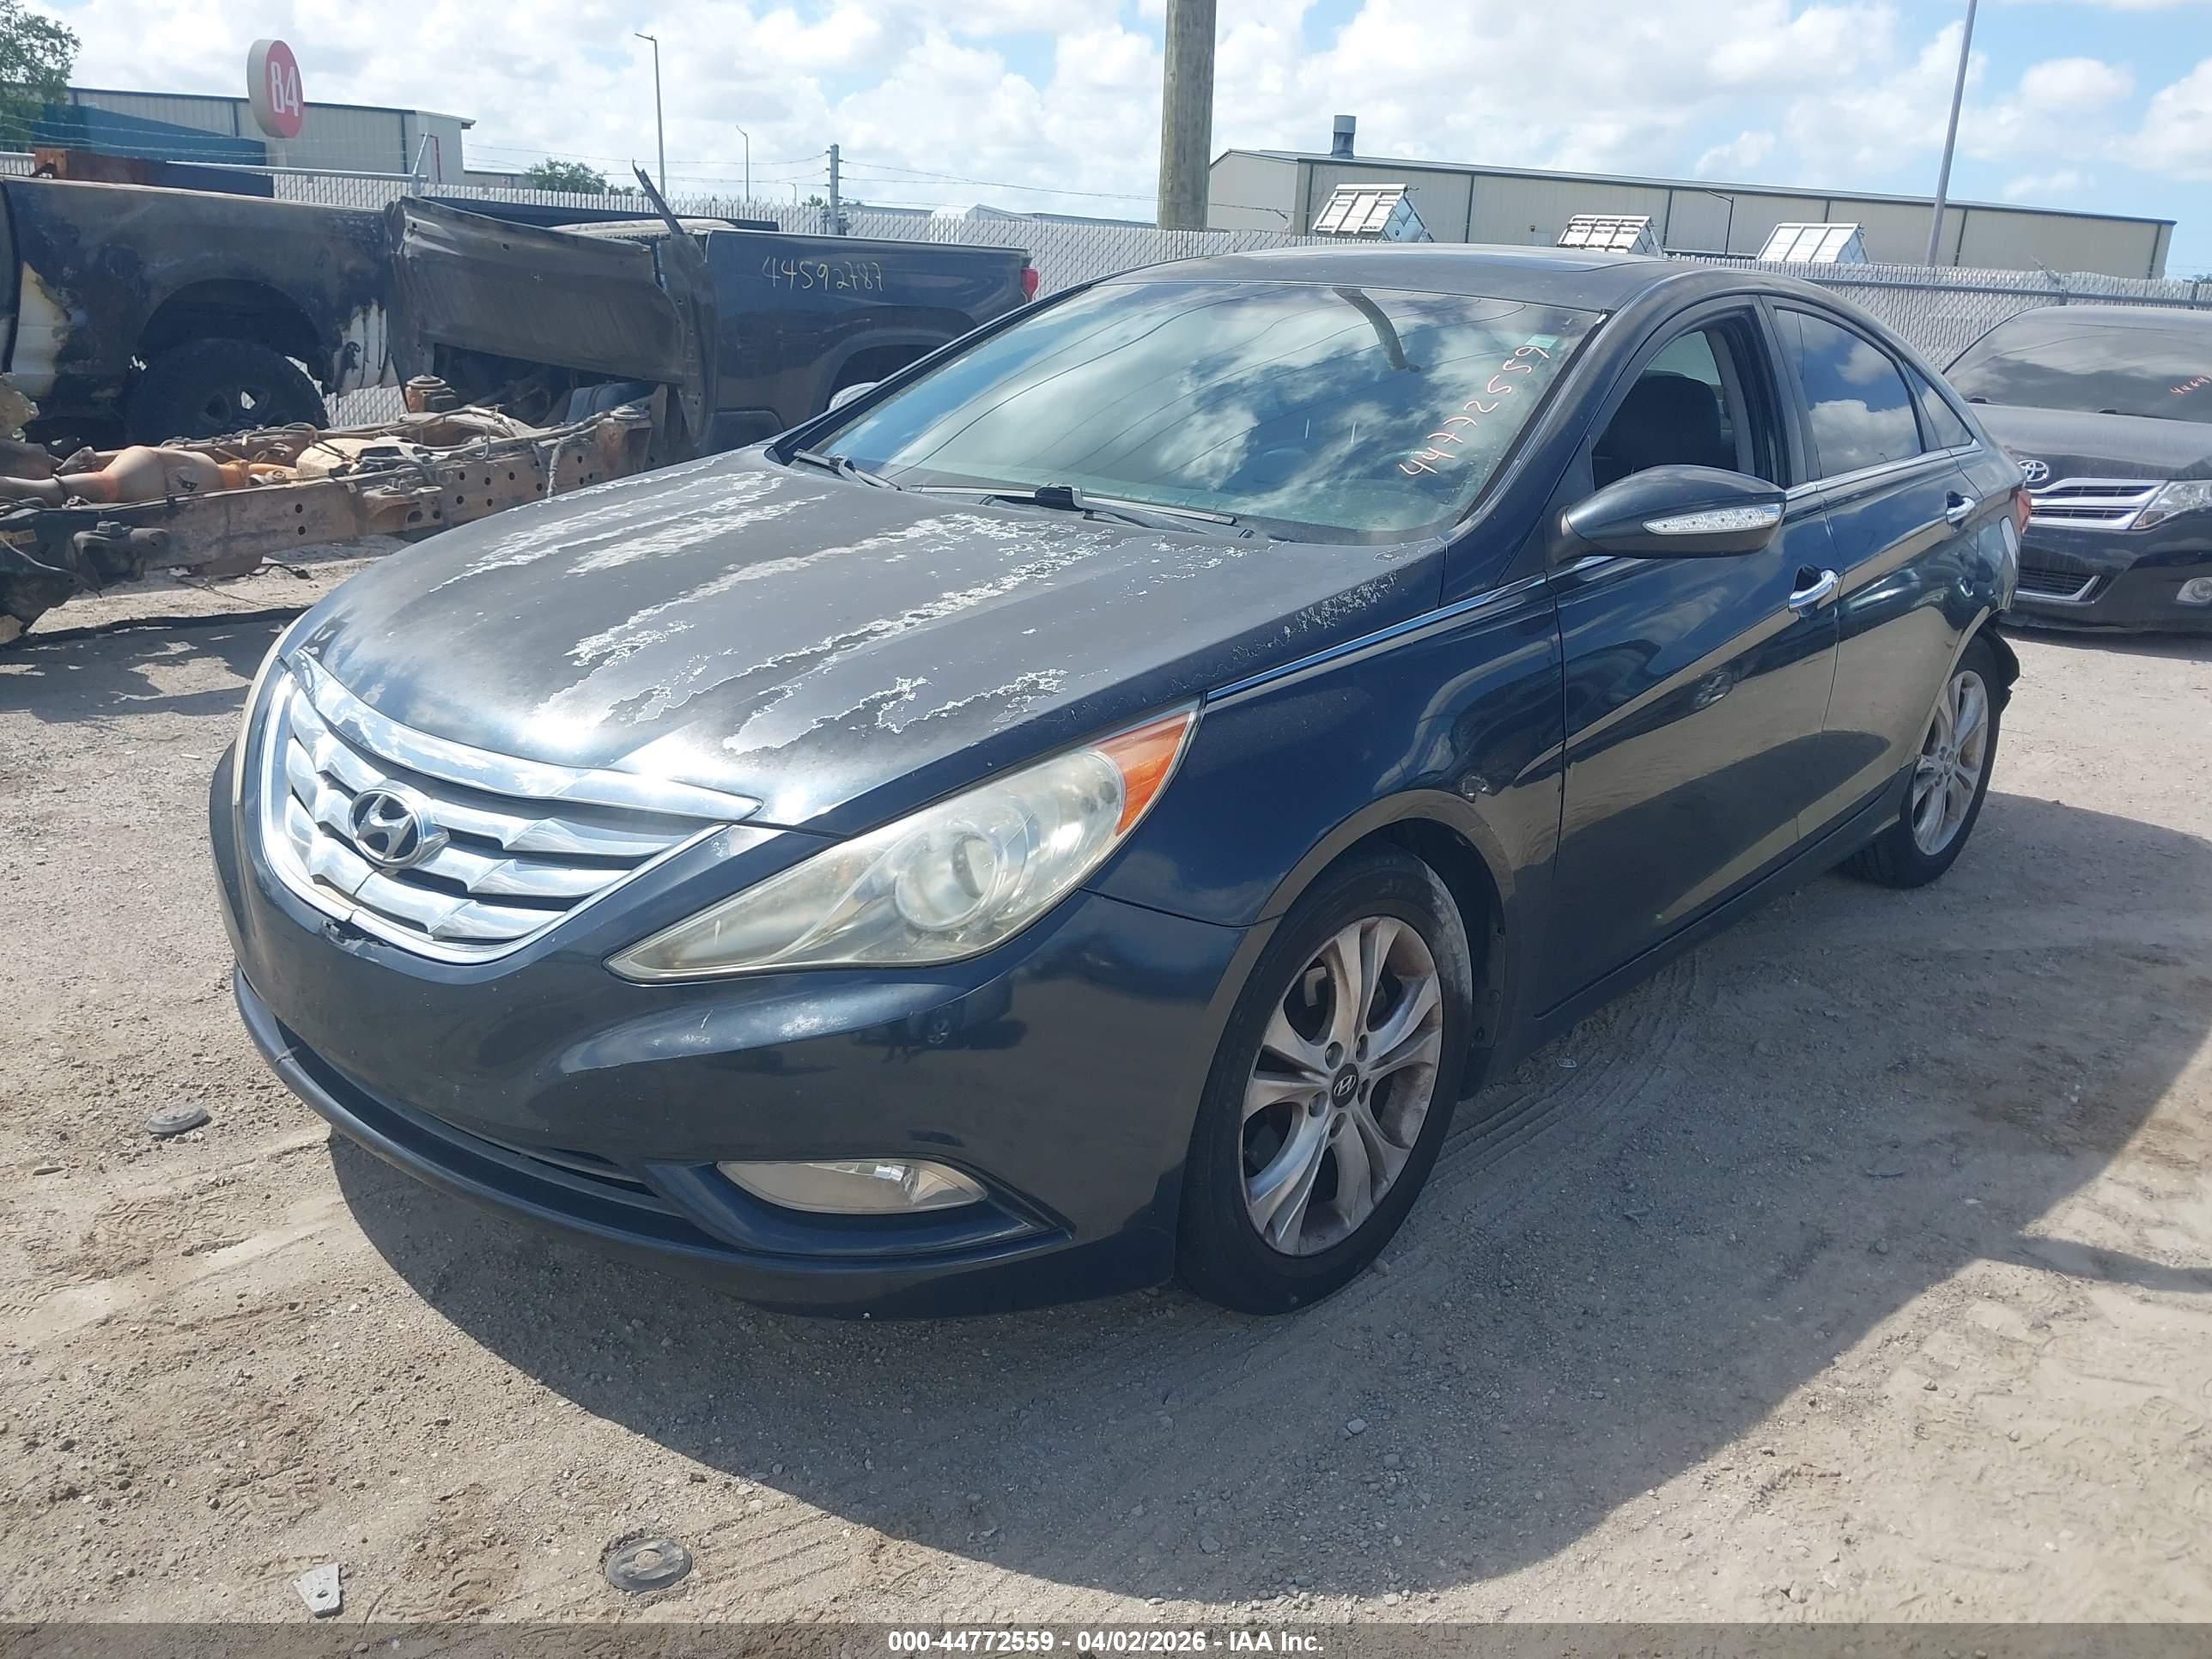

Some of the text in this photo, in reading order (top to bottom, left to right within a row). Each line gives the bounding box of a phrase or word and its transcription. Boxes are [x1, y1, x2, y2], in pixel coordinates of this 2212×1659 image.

[270, 61, 299, 117] 84
[763, 256, 884, 291] 44592787
[1399, 346, 1550, 475] 44772559
